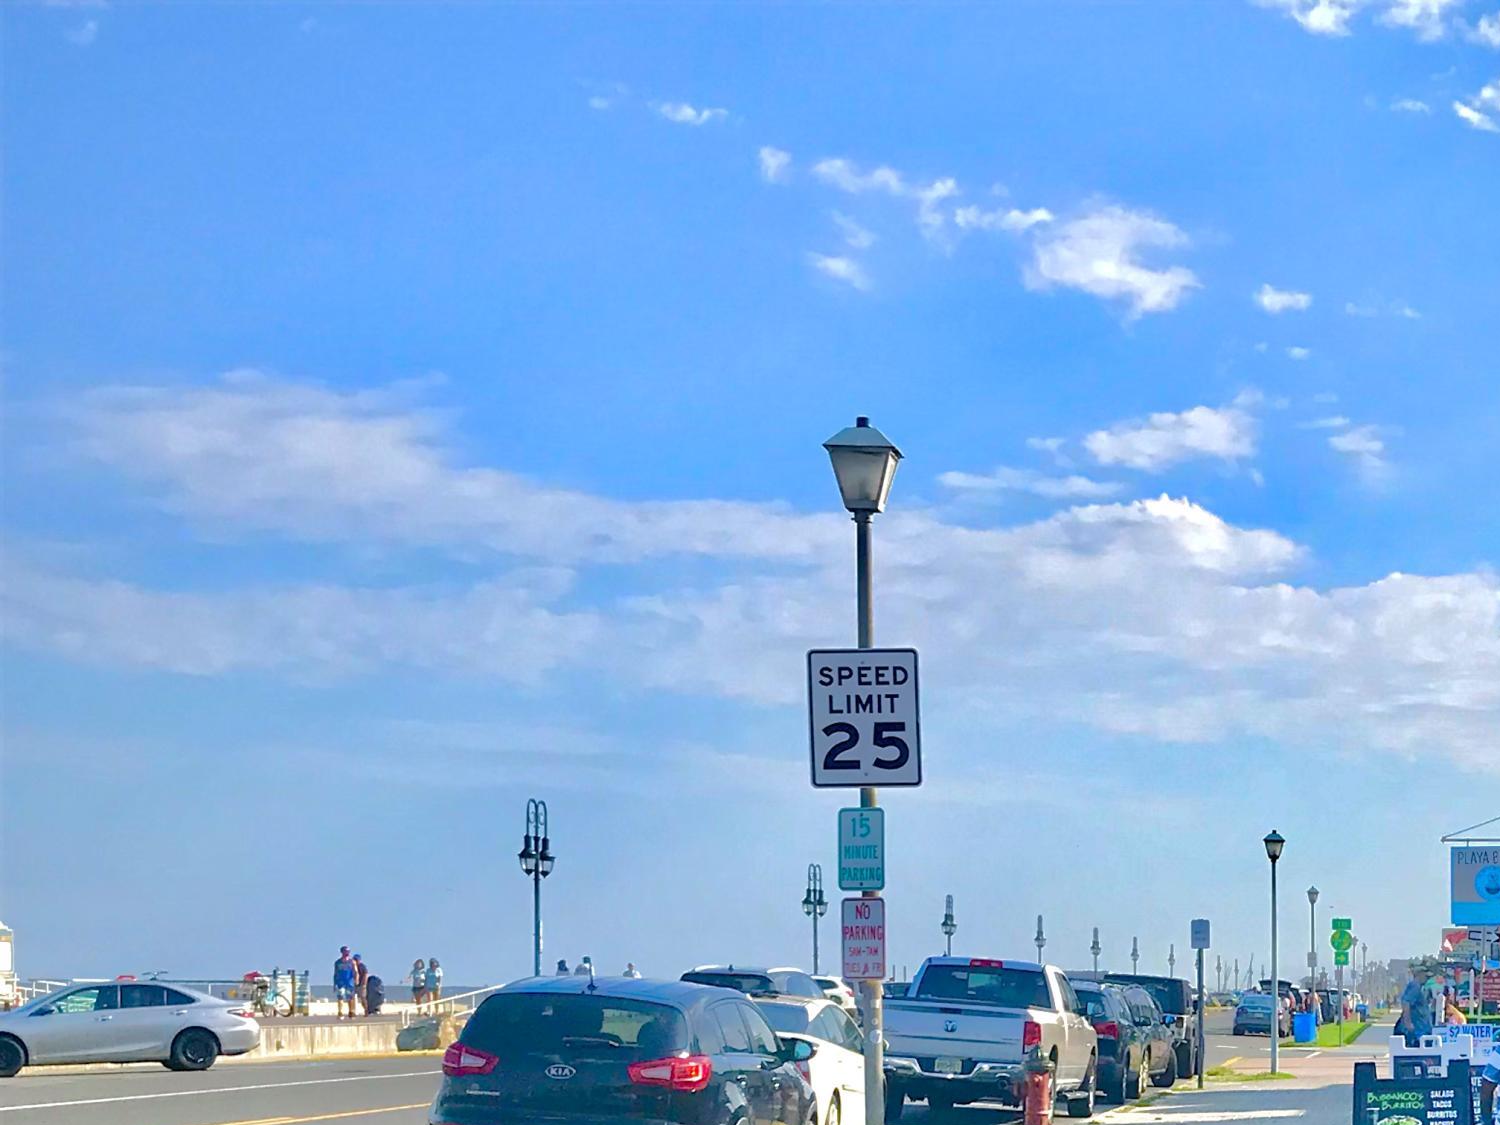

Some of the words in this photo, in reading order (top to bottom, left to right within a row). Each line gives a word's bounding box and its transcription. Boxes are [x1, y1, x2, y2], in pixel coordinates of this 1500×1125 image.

[818, 666, 909, 687] SPEED
[829, 694, 900, 715] LIMIT
[821, 722, 910, 770] 25
[850, 817, 871, 838] 15
[844, 845, 878, 860] MINUTE
[1457, 852, 1489, 865] PLAYA
[841, 867, 881, 882] PARKING
[855, 905, 871, 920] NO
[843, 926, 883, 941] PARKING
[1449, 1026, 1459, 1038] $2
[1462, 1026, 1491, 1038] WATER
[550, 1068, 570, 1076] KIA
